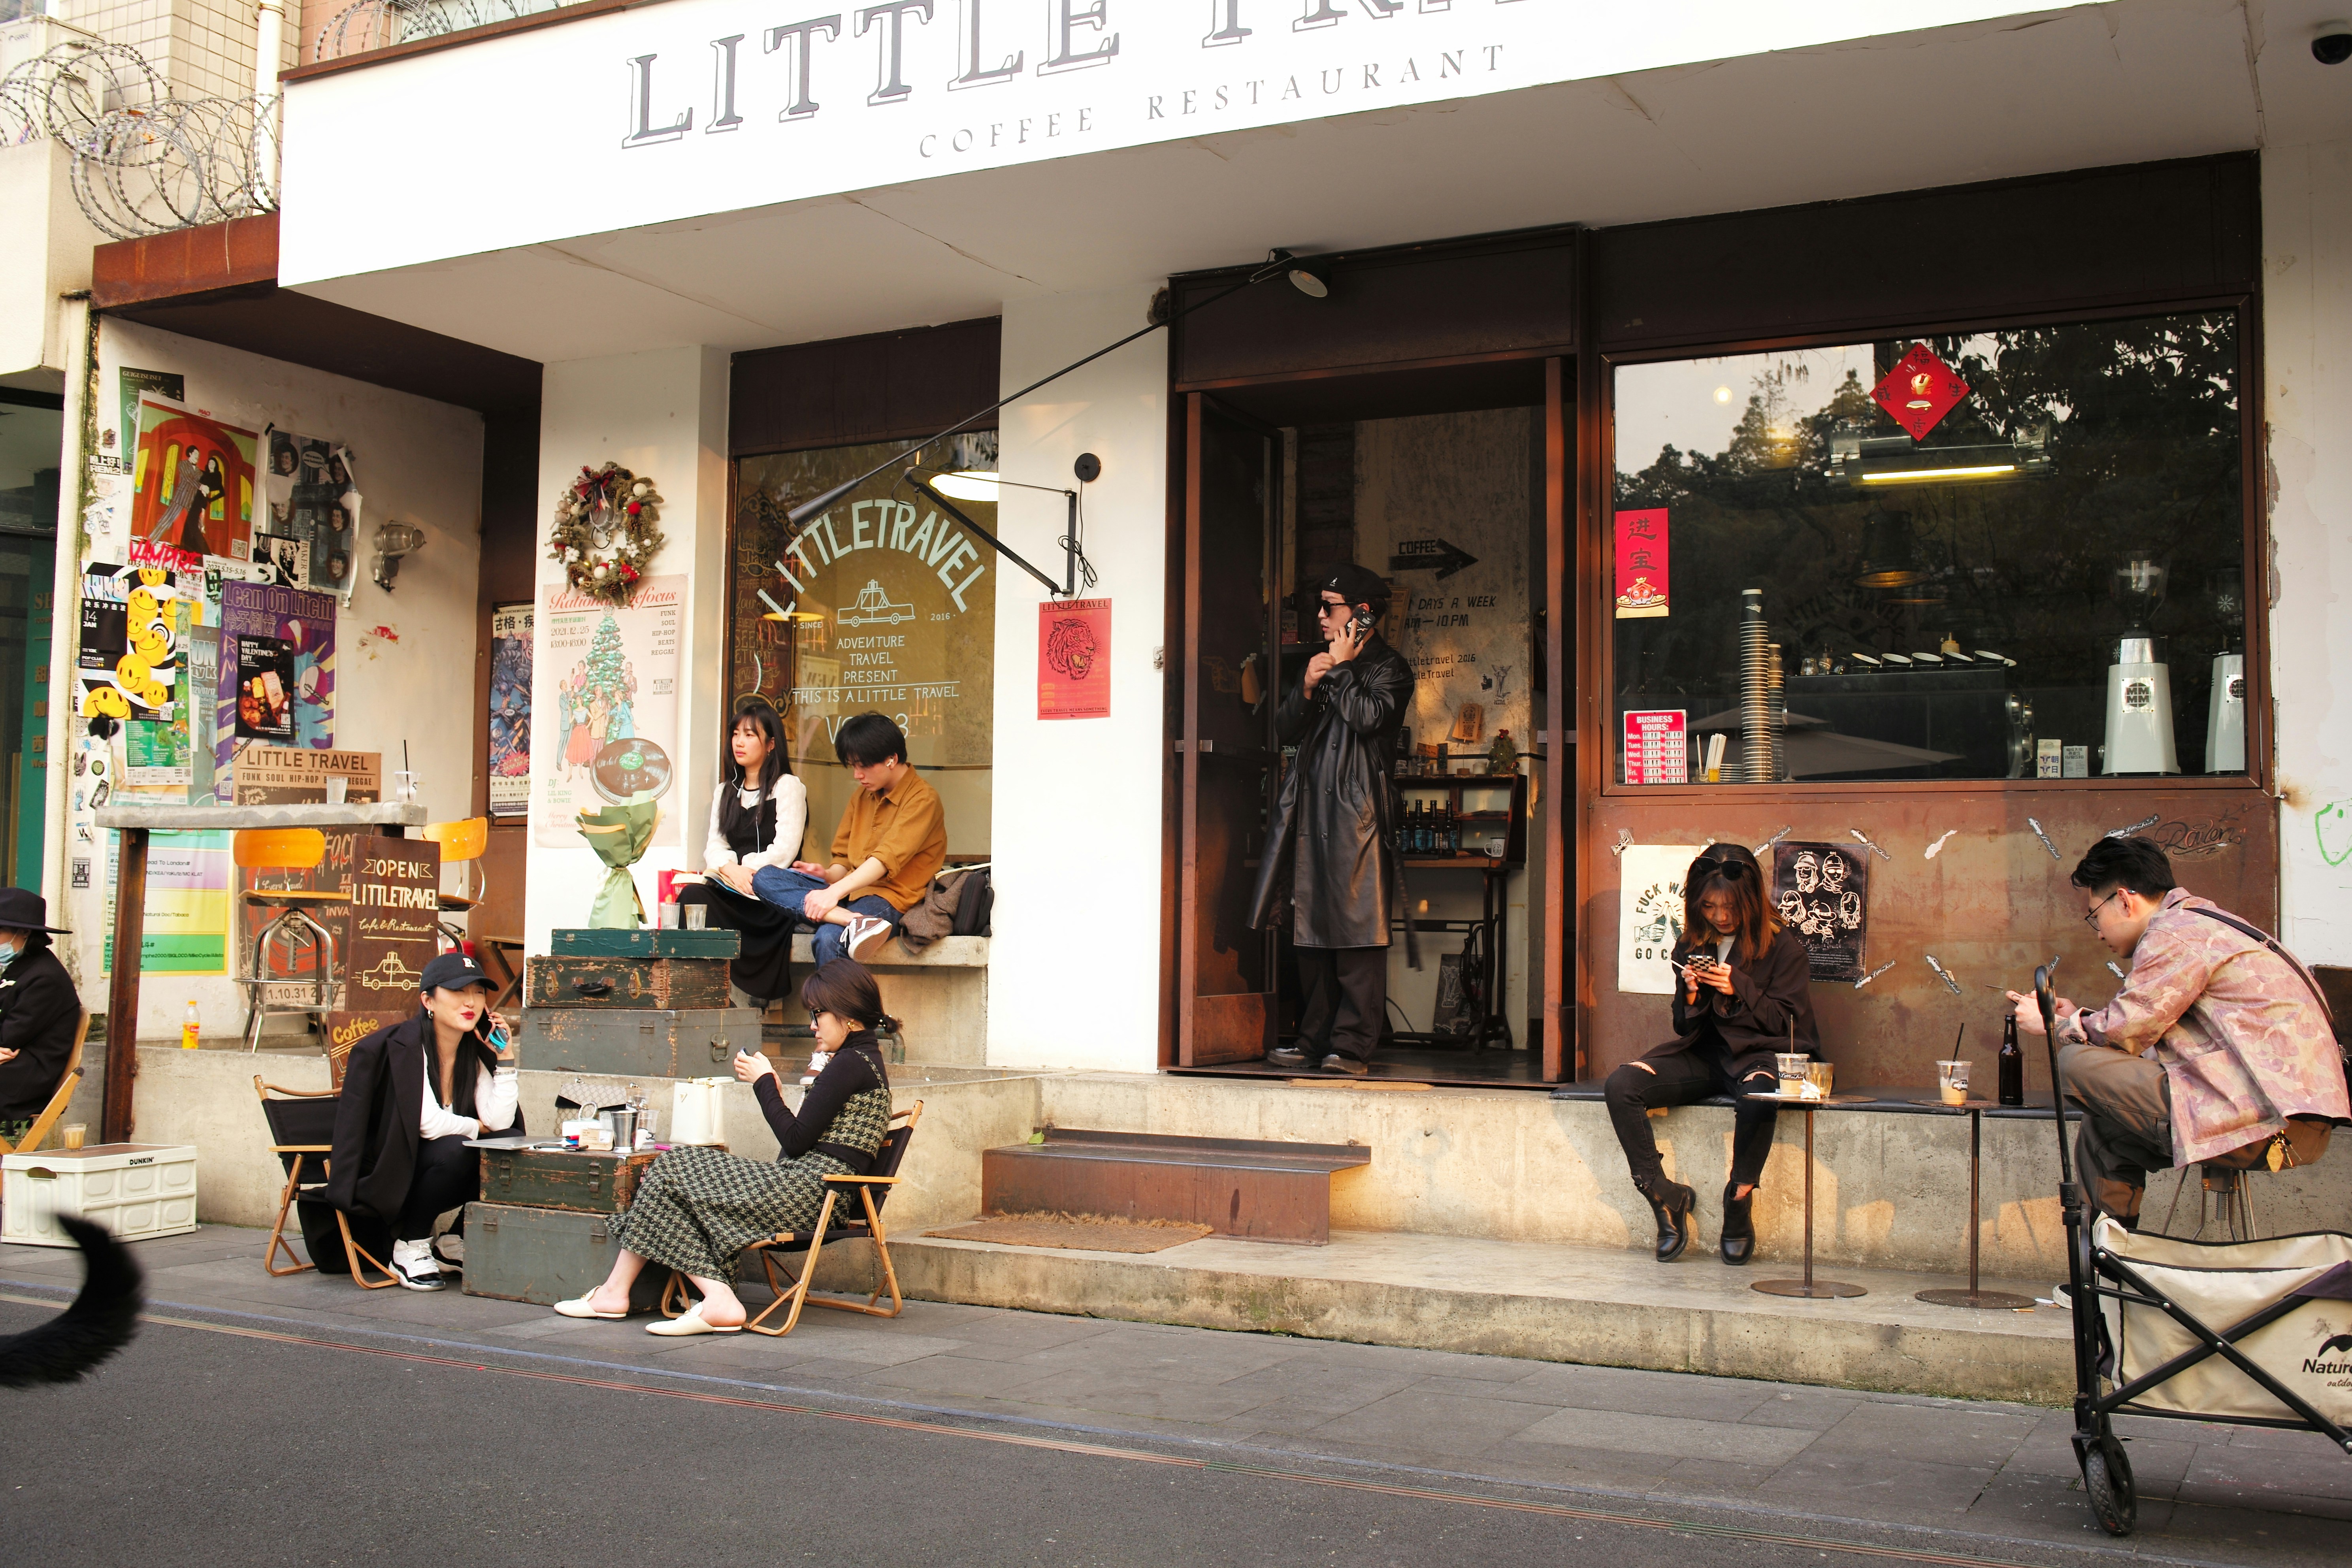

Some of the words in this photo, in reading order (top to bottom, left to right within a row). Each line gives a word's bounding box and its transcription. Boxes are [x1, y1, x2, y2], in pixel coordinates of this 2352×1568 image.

[622, 0, 1119, 149] LITTLE
[920, 107, 1092, 158] COFFEE
[1148, 44, 1505, 121] RESTAURANT
[737, 535, 766, 555] Little
[1398, 539, 1436, 554] COFFEE
[1628, 518, 1658, 571] 进宝
[129, 538, 203, 573] VAMPIRE
[746, 550, 771, 567] Travel
[757, 499, 985, 621] LITTLETRAVEL
[737, 578, 760, 589] COFFEE
[85, 600, 126, 611] 快乐冲击波
[224, 581, 264, 610] Lean
[267, 587, 288, 614] On
[291, 591, 334, 621] Litchi
[1042, 602, 1071, 611] LITTLE
[1075, 600, 1108, 609] TRAVEL
[1418, 598, 1444, 611] DAYS
[1451, 597, 1459, 609] A
[1468, 596, 1496, 607] WEEK
[84, 610, 98, 622] 14
[930, 612, 951, 621] 2016
[551, 626, 590, 636] 2021.12.25
[837, 635, 905, 649] ADVENTURE
[191, 639, 217, 666] UN
[241, 647, 274, 657] VALENTINE'S
[735, 648, 771, 665] ETURN
[849, 652, 893, 666] TRAVEL
[1407, 654, 1454, 666] ttletravel
[1457, 654, 1476, 663] 2016
[191, 665, 205, 678] ty
[206, 666, 217, 679] K
[844, 669, 898, 684] PRESENT
[191, 686, 216, 695] 021/07/17
[792, 690, 822, 705] THIS
[828, 690, 840, 703] IS
[845, 689, 854, 703] A
[858, 688, 906, 703] LITTLE
[914, 686, 959, 699] TRAVEL
[1636, 715, 1673, 724] BUSINESS
[31, 759, 47, 768] Wes
[247, 750, 303, 768] LITTLE
[309, 752, 368, 771] TRAVEL
[242, 772, 261, 782] FUNK
[266, 773, 284, 782] SOUL
[289, 774, 319, 784] HIP-HOP
[347, 776, 372, 786] REGGAE
[548, 779, 559, 788] DJ:
[548, 810, 568, 820] Merry
[376, 859, 418, 880] OPEN
[262, 879, 283, 891] Every
[341, 873, 352, 884] LI
[339, 885, 352, 893] TR
[352, 883, 439, 910] LITTLETRAVEL
[1636, 883, 1662, 914] FUCK
[326, 906, 351, 918] INVA
[359, 918, 379, 934] Cafe
[380, 920, 387, 930] &
[1635, 948, 1652, 960] GO
[462, 957, 475, 969] R
[332, 1017, 380, 1045] Coffee
[129, 1157, 155, 1165] DUNKIN'
